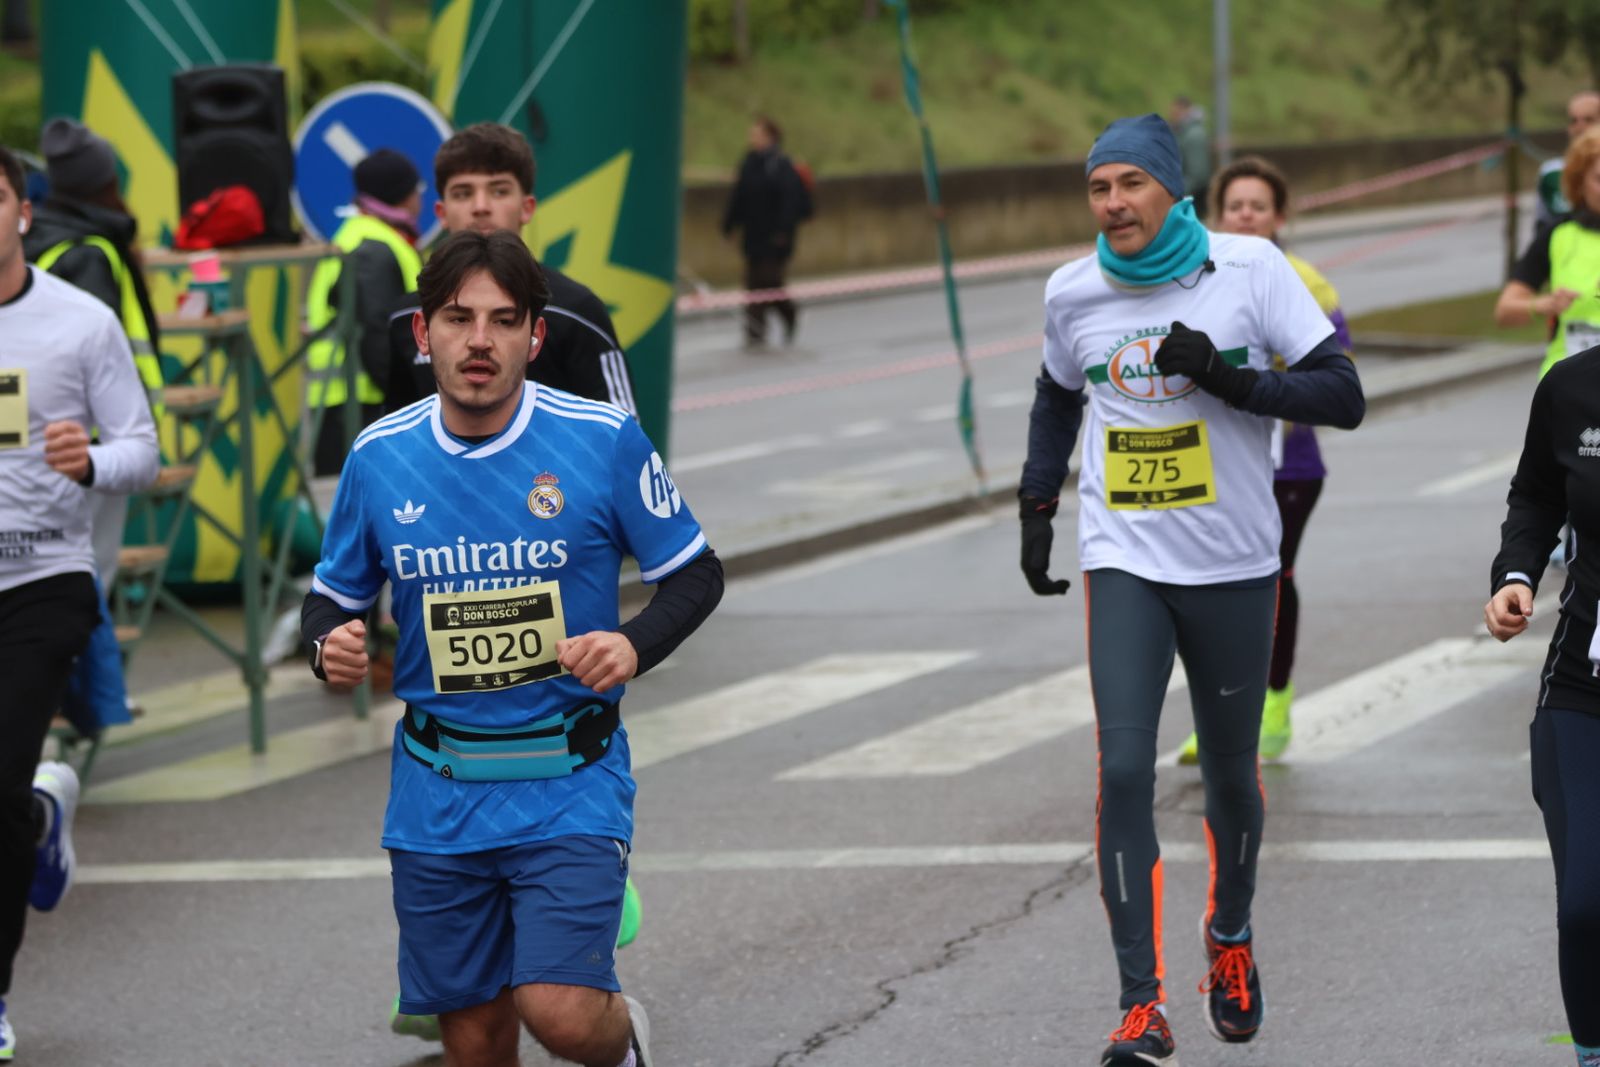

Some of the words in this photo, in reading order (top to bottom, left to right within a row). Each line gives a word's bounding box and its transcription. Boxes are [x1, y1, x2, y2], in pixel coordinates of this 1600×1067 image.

[1136, 326, 1168, 338] DEPO
[1146, 439, 1174, 448] BOSCO
[1127, 457, 1181, 484] 275
[647, 457, 677, 518] hp
[392, 535, 568, 580] Emirates
[463, 611, 485, 621] DON
[486, 608, 519, 620] BOSCO
[478, 602, 507, 611] CARRERA
[508, 599, 537, 608] POPULAR
[449, 628, 542, 667] 5020
